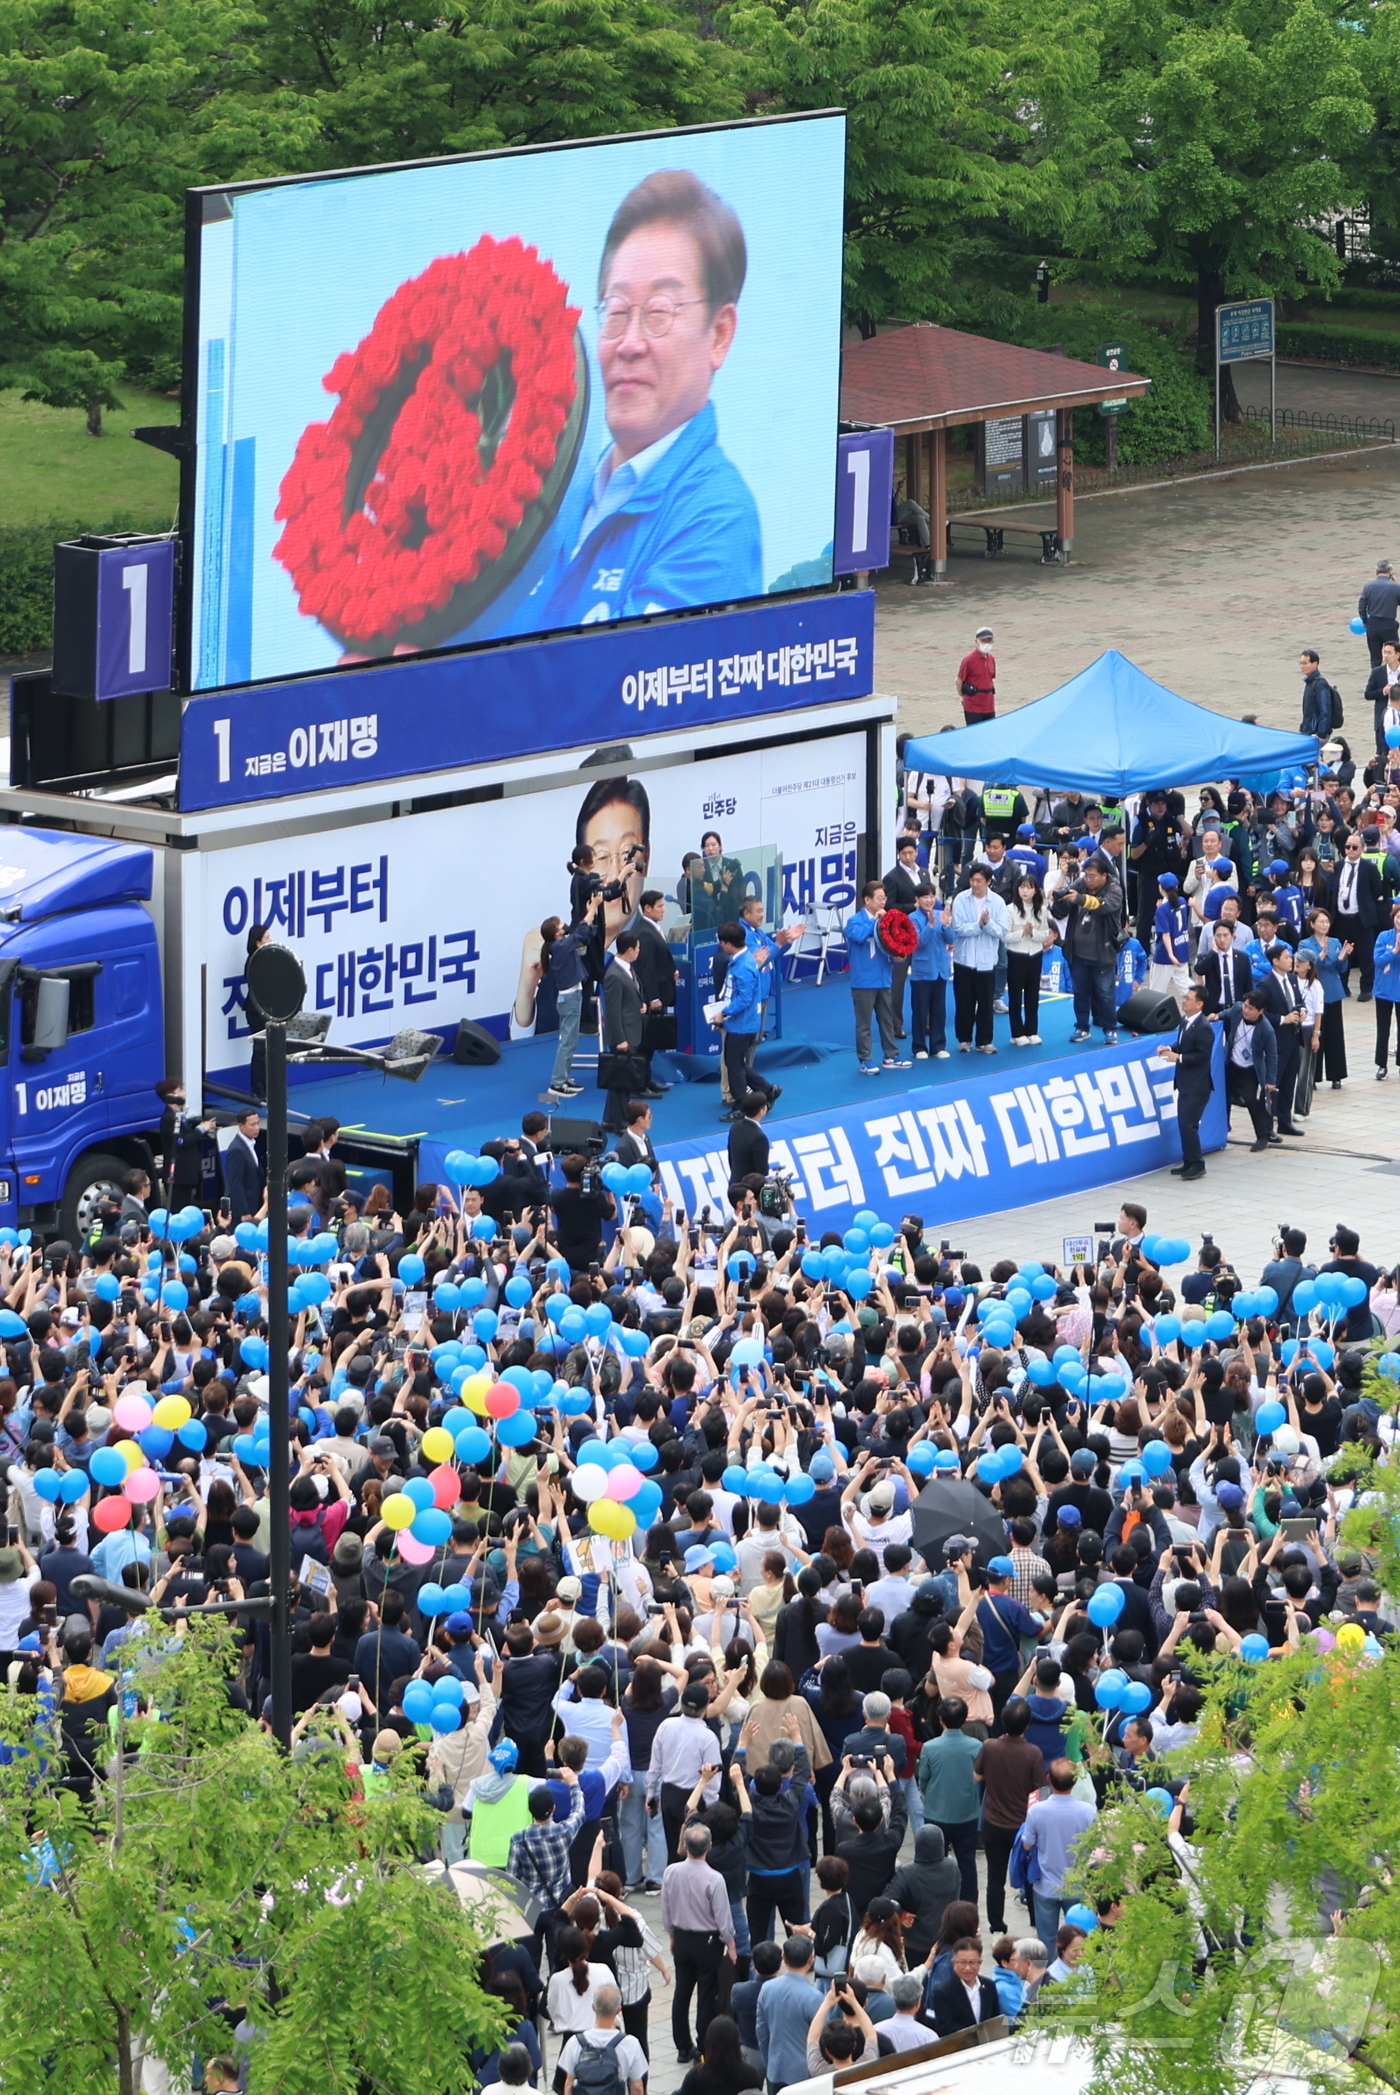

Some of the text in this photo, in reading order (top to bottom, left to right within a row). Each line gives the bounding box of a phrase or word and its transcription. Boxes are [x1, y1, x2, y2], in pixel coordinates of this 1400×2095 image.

[847, 449, 870, 553] 1
[122, 563, 148, 674] 1
[621, 636, 859, 711] 이제부터 진짜 대한민국
[213, 708, 379, 783] 1 지금은 이재명
[702, 796, 738, 820] 민주당
[814, 820, 857, 847] 지금은
[222, 853, 389, 939] 이제부터
[315, 929, 481, 1019] 대한민국
[15, 1081, 87, 1115] 1 이재명
[66, 1070, 86, 1083] 지금은
[864, 1099, 991, 1198] 진짜
